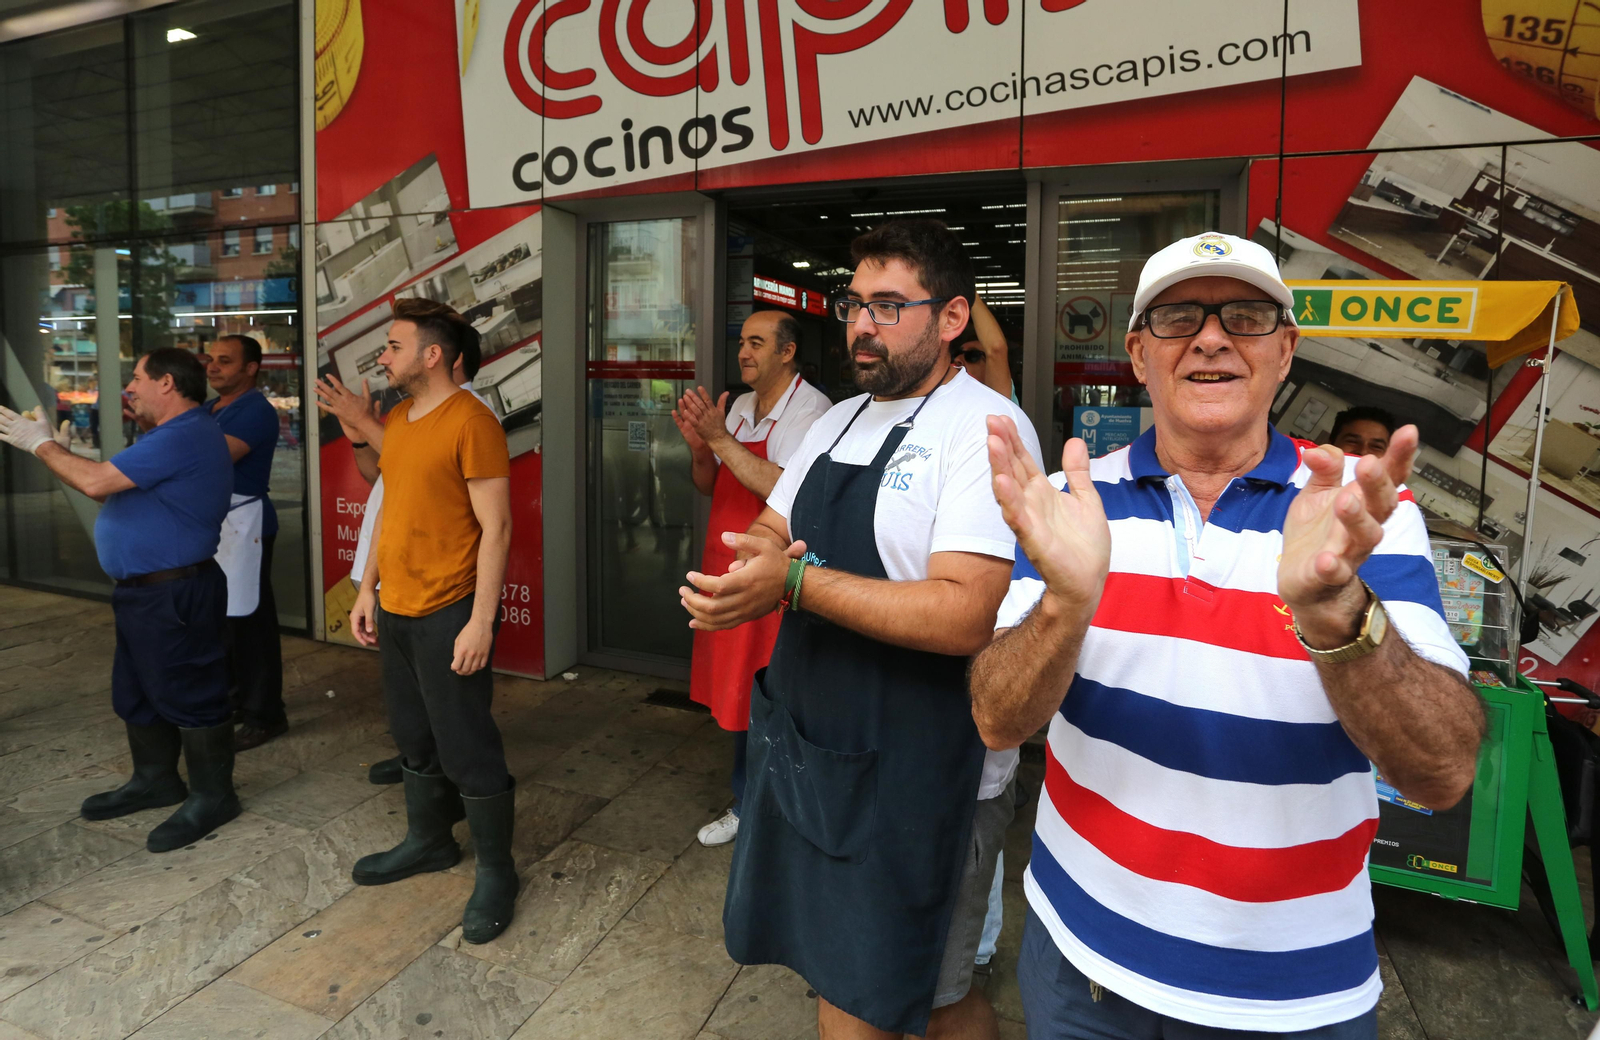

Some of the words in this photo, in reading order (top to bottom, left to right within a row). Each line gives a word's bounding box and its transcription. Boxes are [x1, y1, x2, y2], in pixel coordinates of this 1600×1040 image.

[1502, 14, 1566, 45] 135
[847, 30, 1312, 128] www.cocinascapis.com
[512, 105, 754, 192] cocinas
[1340, 296, 1462, 324] ONCE
[1373, 838, 1399, 848] PREMIOS
[1431, 862, 1456, 872] ONCE
